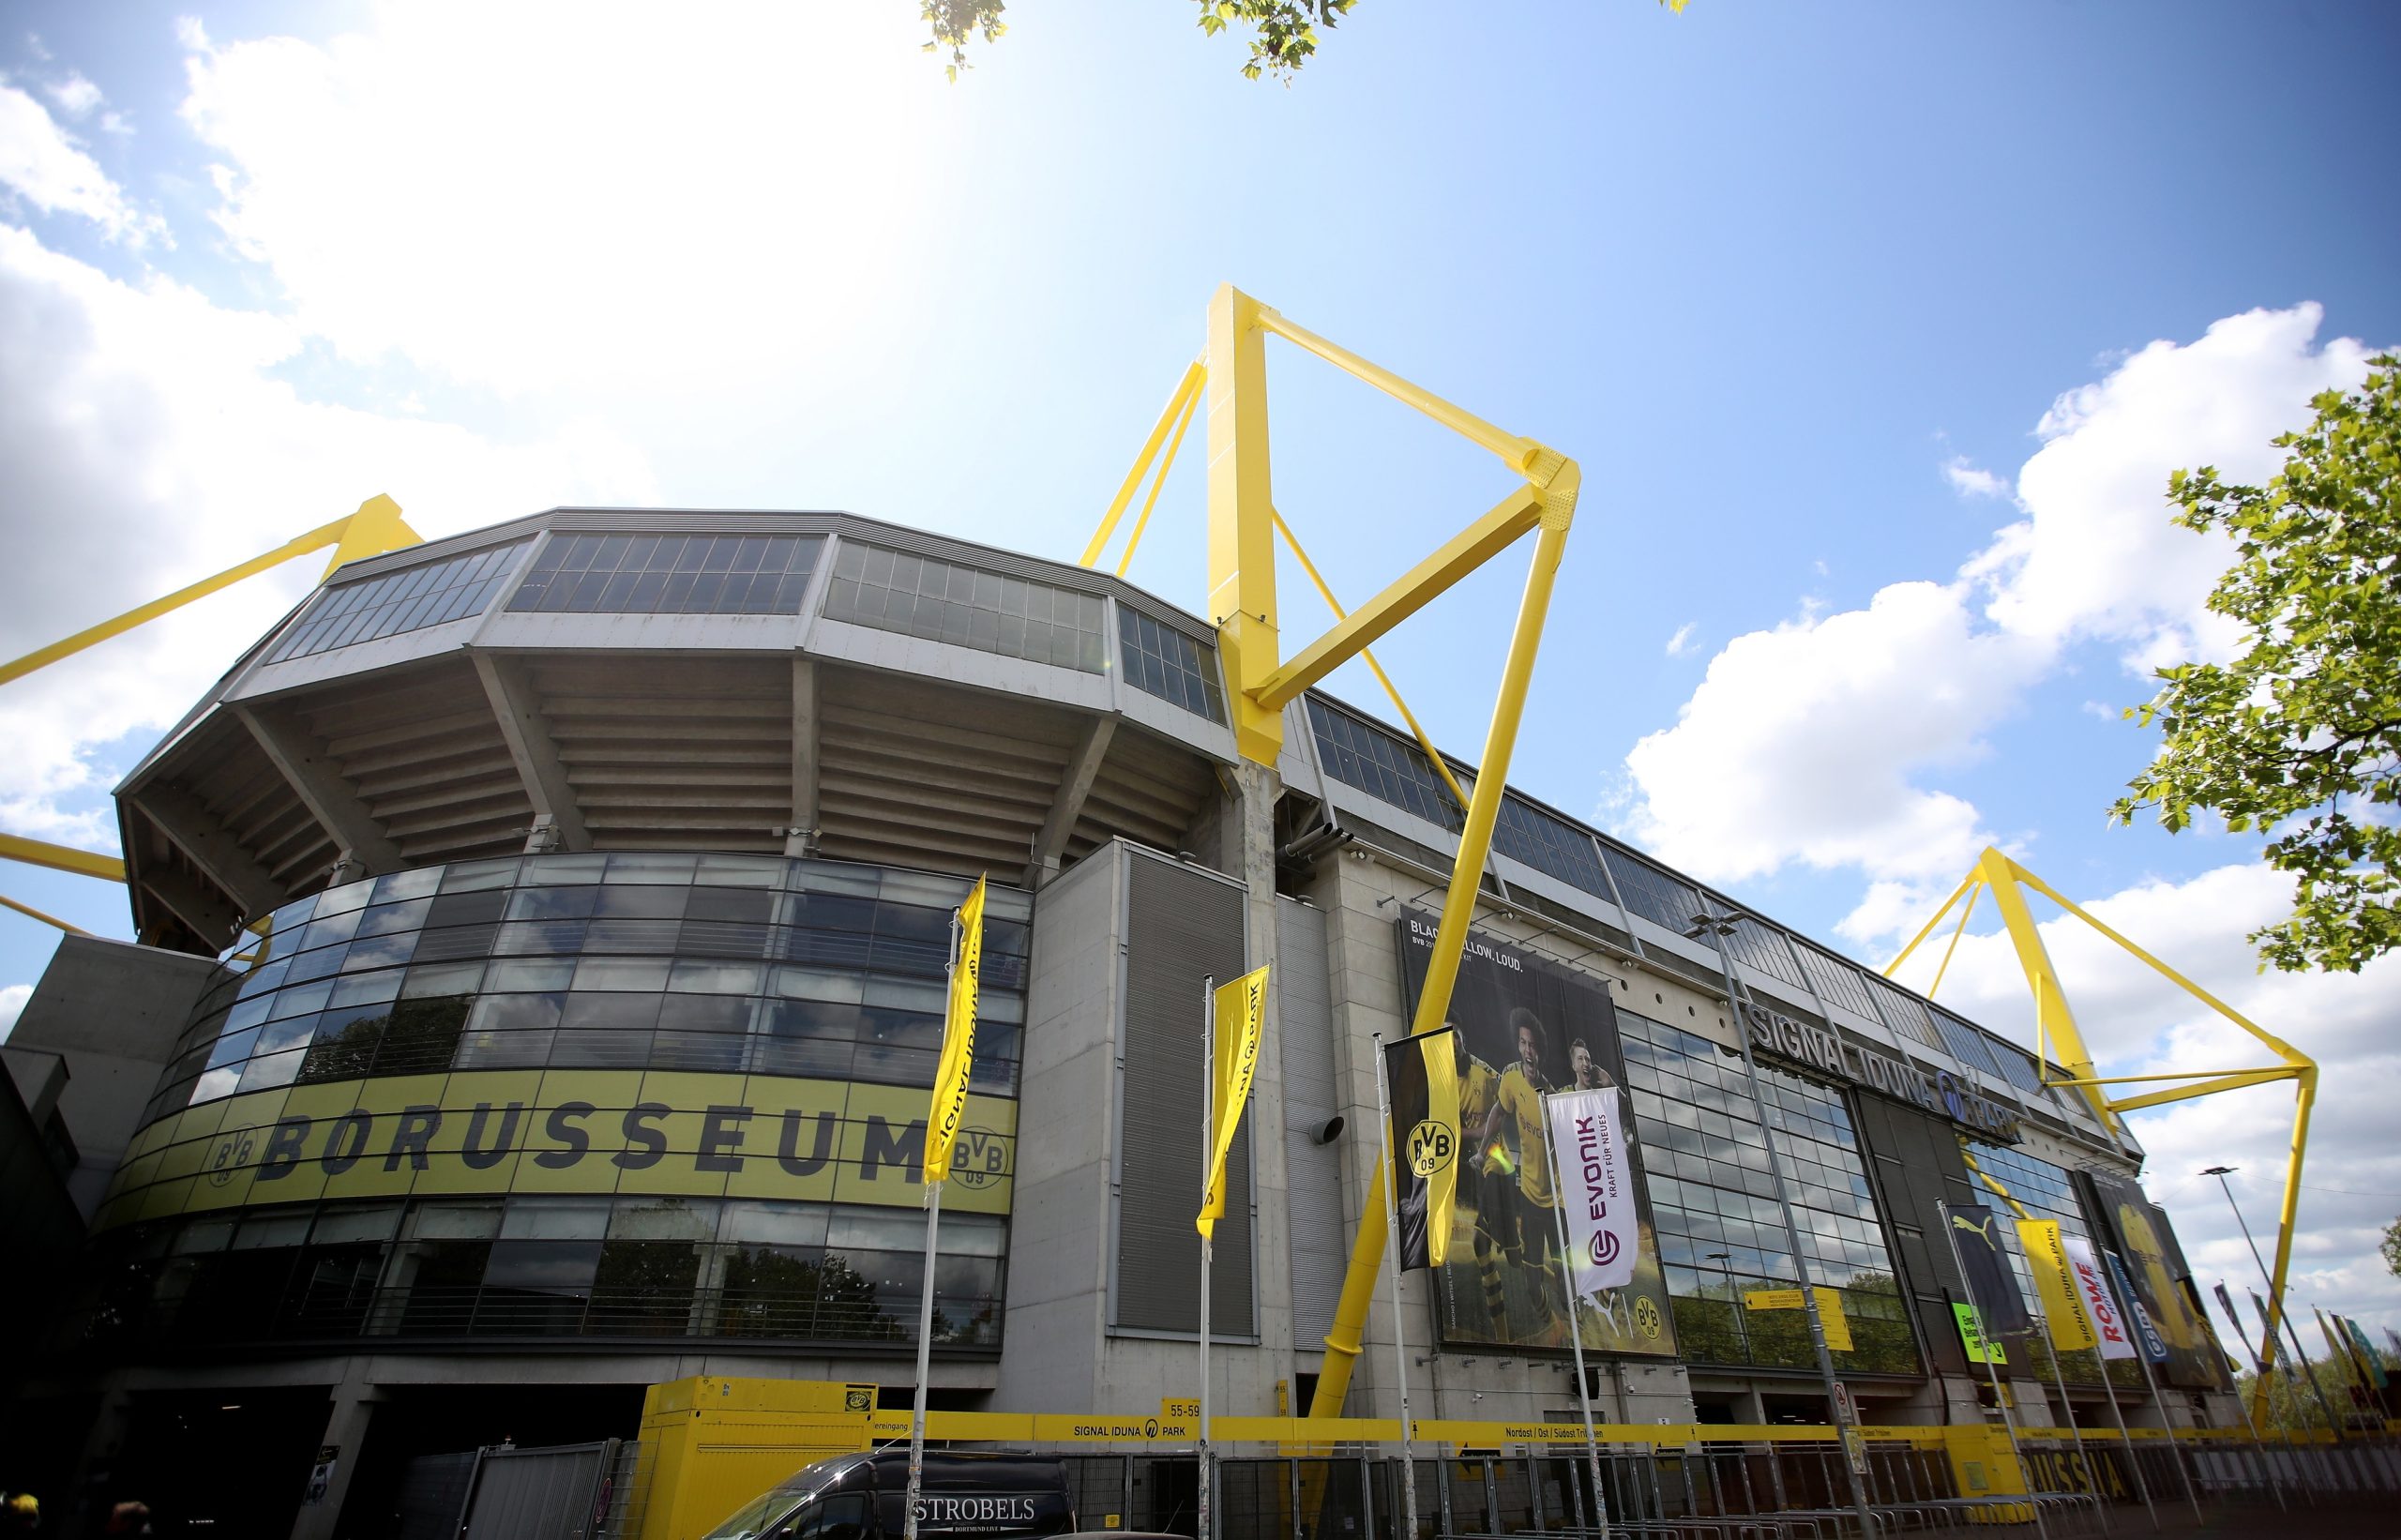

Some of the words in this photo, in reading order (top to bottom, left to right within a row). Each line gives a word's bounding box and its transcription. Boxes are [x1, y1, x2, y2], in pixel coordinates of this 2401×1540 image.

[1410, 919, 1439, 939] BLAC
[1463, 940, 1495, 961] LLOW.
[1495, 951, 1523, 973] LOUD.
[1412, 936, 1425, 946] BVB
[1745, 1003, 1858, 1080] SIGNAL
[1856, 1048, 1937, 1111] IDUNA
[1598, 1114, 1609, 1144] NEUES
[214, 1128, 254, 1170] BVB
[256, 1101, 928, 1185] BORUSSEUM
[951, 1132, 1004, 1173] BVB
[1413, 1125, 1450, 1163] BVB
[1602, 1147, 1613, 1166] FÜR
[1421, 1157, 1435, 1171] 09
[1575, 1116, 1607, 1221] EVONIK
[964, 1171, 984, 1185] 09
[1609, 1170, 1618, 1198] KRAFT
[1637, 1300, 1659, 1327] BVB
[2076, 1261, 2124, 1343] ROWE
[1170, 1405, 1200, 1417] 55-59
[873, 1422, 909, 1432] ereingang
[1074, 1426, 1109, 1437] SIGNAL
[1111, 1426, 1141, 1437] IDUNA
[1162, 1427, 1185, 1437] PARK
[1505, 1427, 1533, 1438] Nordost
[1538, 1427, 1549, 1438] Ost
[1554, 1427, 1577, 1439] Südost
[1577, 1427, 1604, 1438] Trinen
[917, 1498, 1034, 1520] STROBELS
